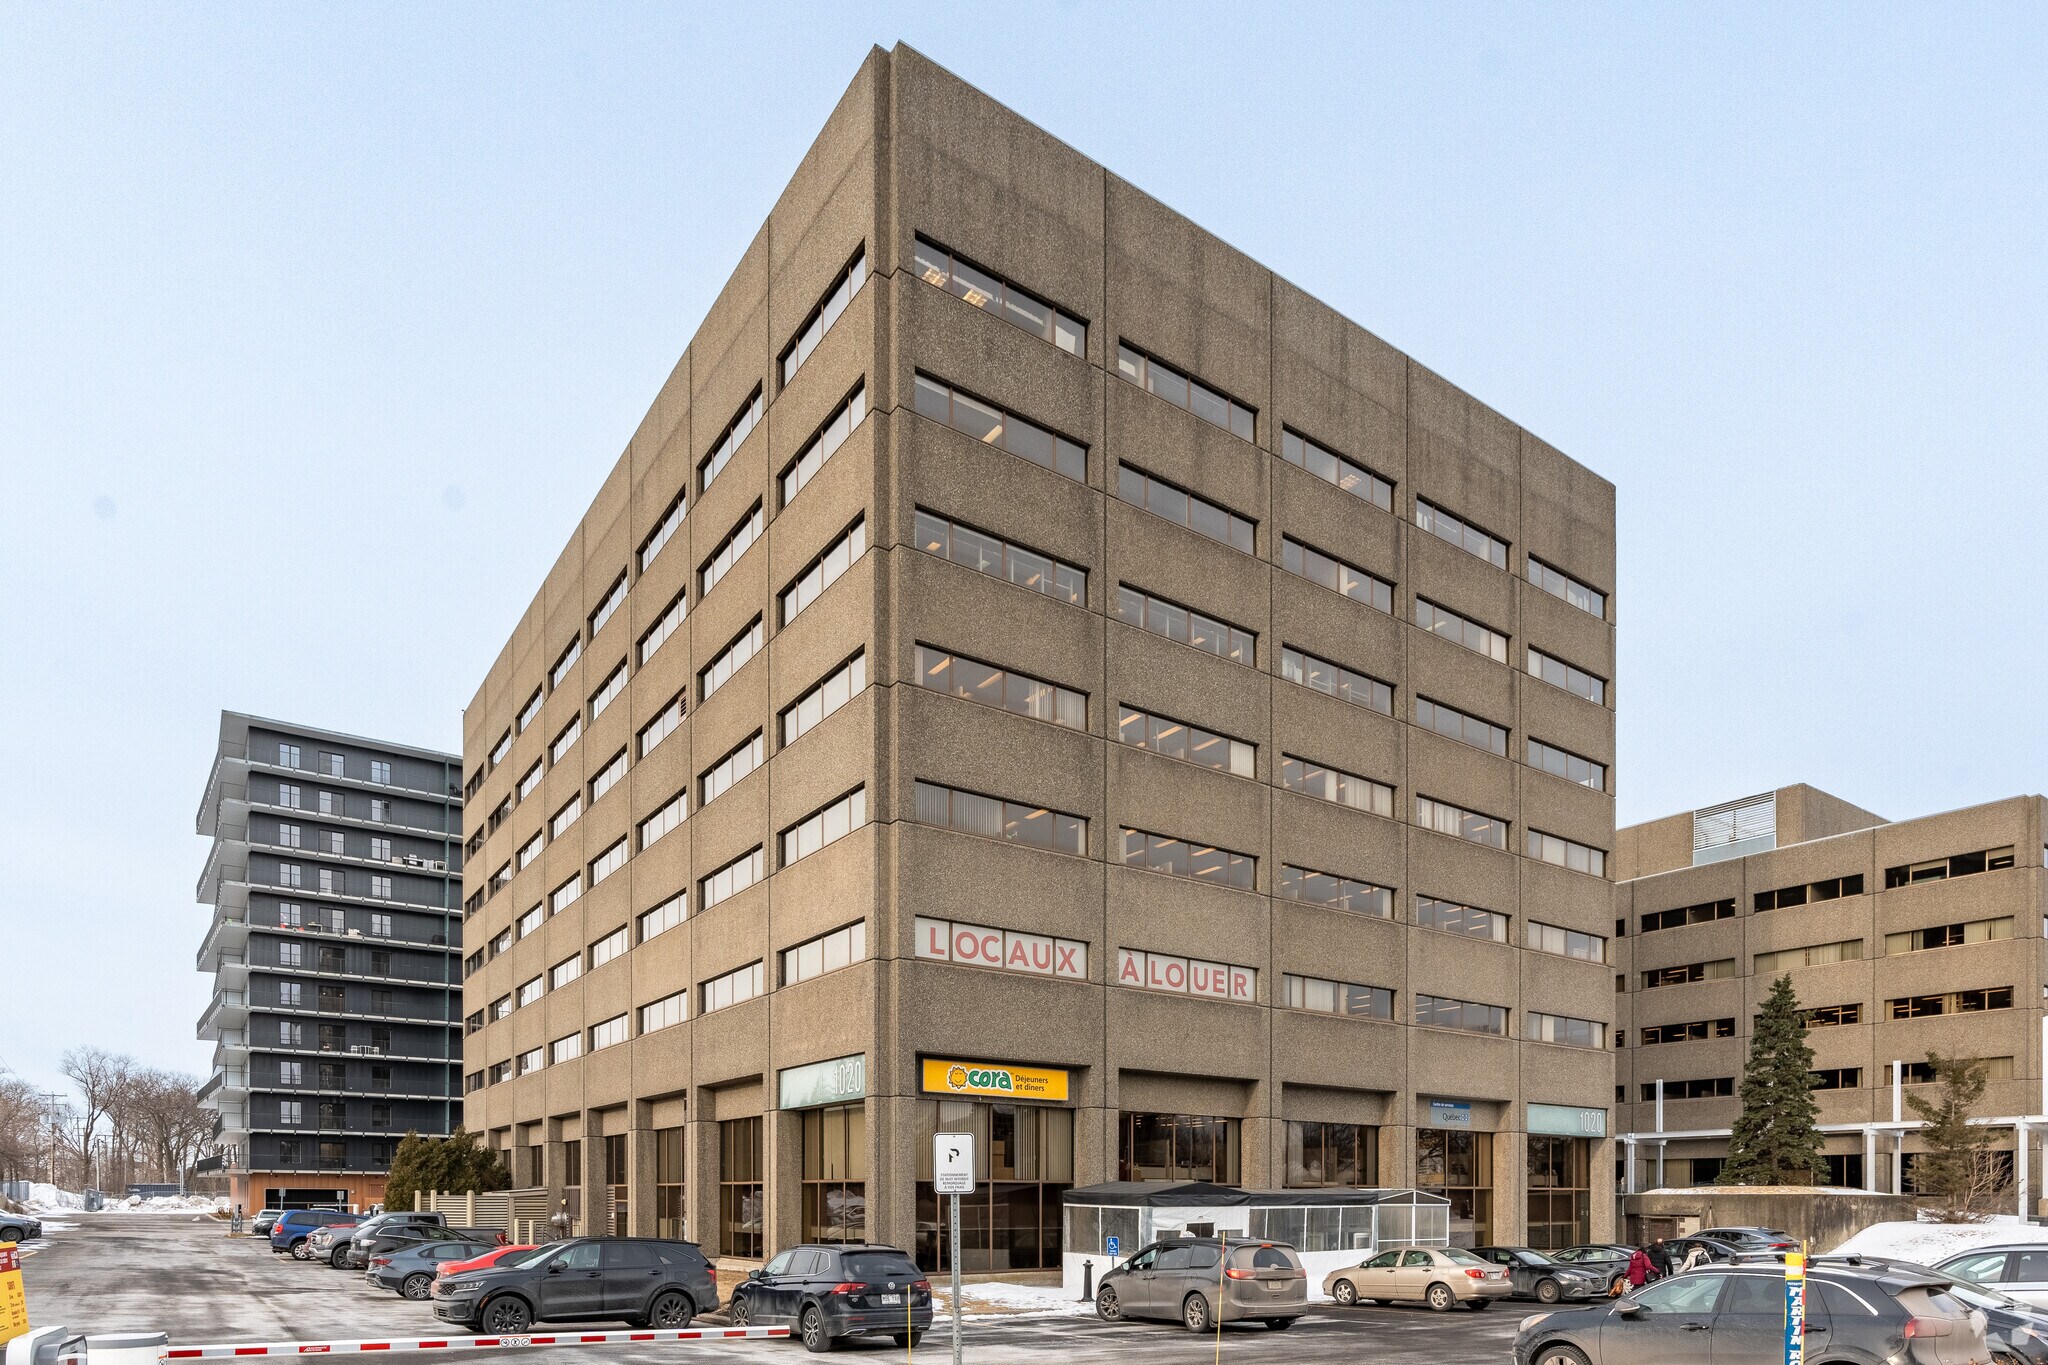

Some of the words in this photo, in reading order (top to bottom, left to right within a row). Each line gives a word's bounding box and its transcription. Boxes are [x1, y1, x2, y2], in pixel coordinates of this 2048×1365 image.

[929, 926, 1078, 974] LOCAUX
[1120, 951, 1141, 983] À
[1150, 960, 1247, 997] LOUER
[834, 1060, 862, 1095] 1020
[968, 1070, 1012, 1090] cora
[1015, 1074, 1049, 1085] Déjeuners
[1442, 1112, 1461, 1122] Québec
[1580, 1112, 1602, 1133] 1020
[1789, 1286, 1803, 1345] MARTIN
